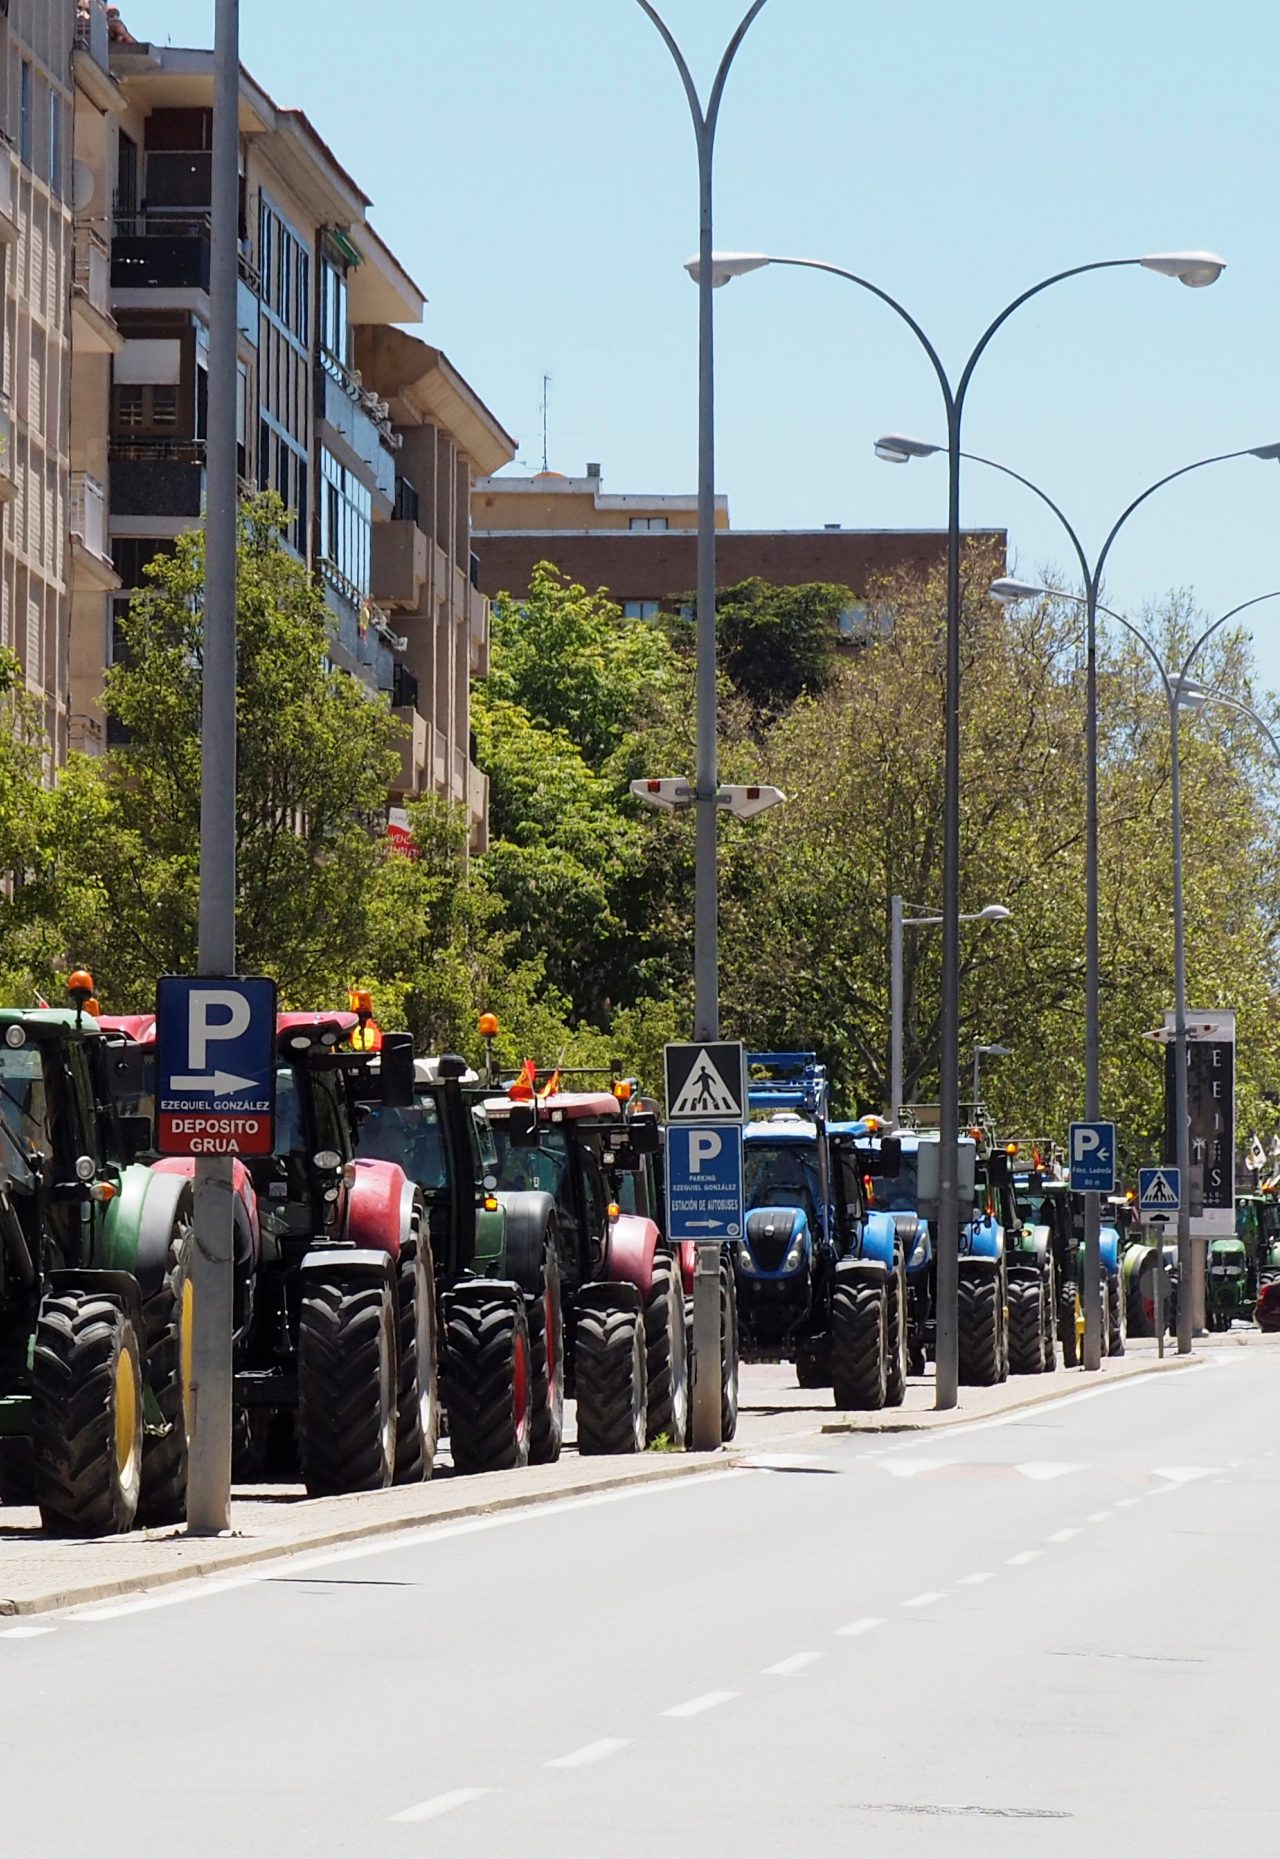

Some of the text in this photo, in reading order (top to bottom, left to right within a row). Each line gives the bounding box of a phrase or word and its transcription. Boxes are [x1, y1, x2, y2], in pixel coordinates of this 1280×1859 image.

[188, 990, 251, 1069] P
[161, 1099, 270, 1111] EZEQUIEL GONZÁLEZ
[172, 1119, 258, 1134] DEPOSITO
[190, 1138, 239, 1152] GRUA
[688, 1130, 722, 1173] P
[1074, 1128, 1100, 1161] P
[704, 1183, 736, 1191] GONZÁLEZ
[672, 1198, 738, 1211] ESTACIÓN DE AUTOBUSES
